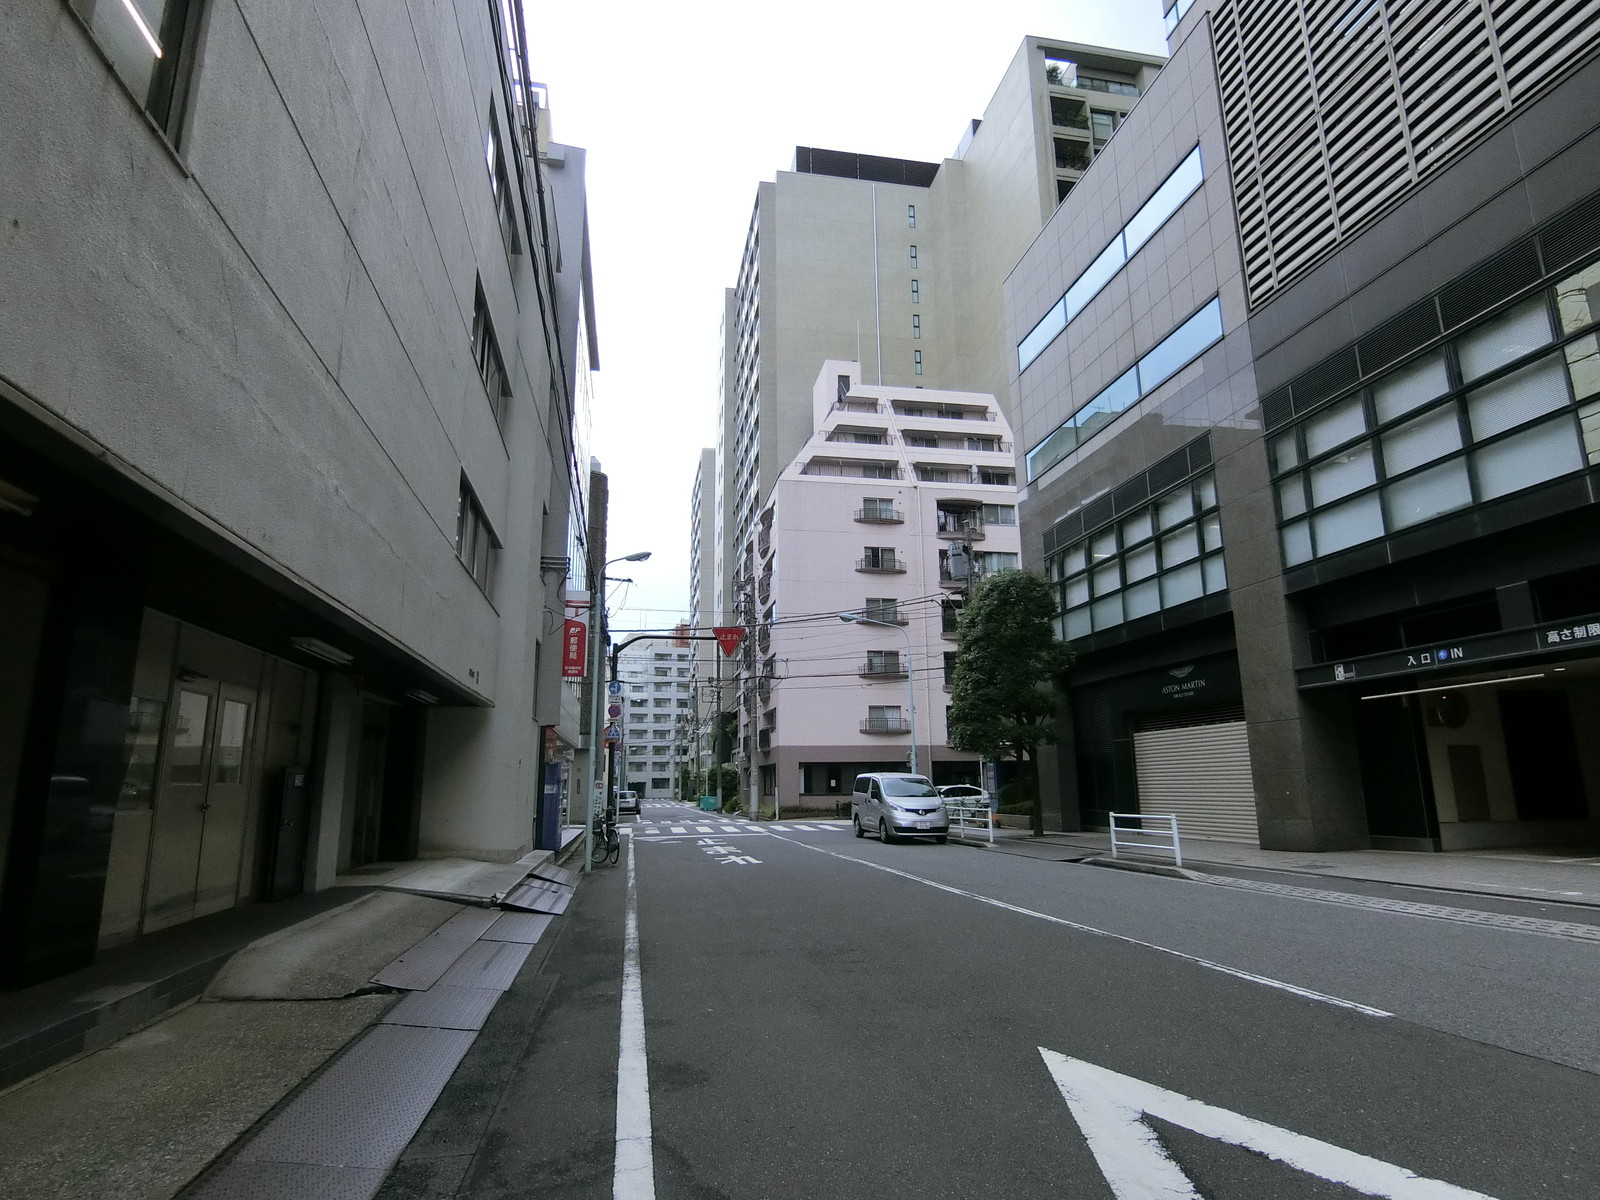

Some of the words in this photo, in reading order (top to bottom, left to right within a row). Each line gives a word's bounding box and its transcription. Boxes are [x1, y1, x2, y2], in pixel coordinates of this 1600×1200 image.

[720, 633, 740, 641] 止まれ
[1546, 623, 1600, 644] 高さ制限
[569, 637, 578, 660] 郵便局
[1407, 653, 1431, 666] 入口
[1450, 647, 1464, 660] IN
[1161, 684, 1180, 695] ASTON
[1181, 679, 1206, 691] MARTIN
[696, 838, 763, 865] 止まれ
